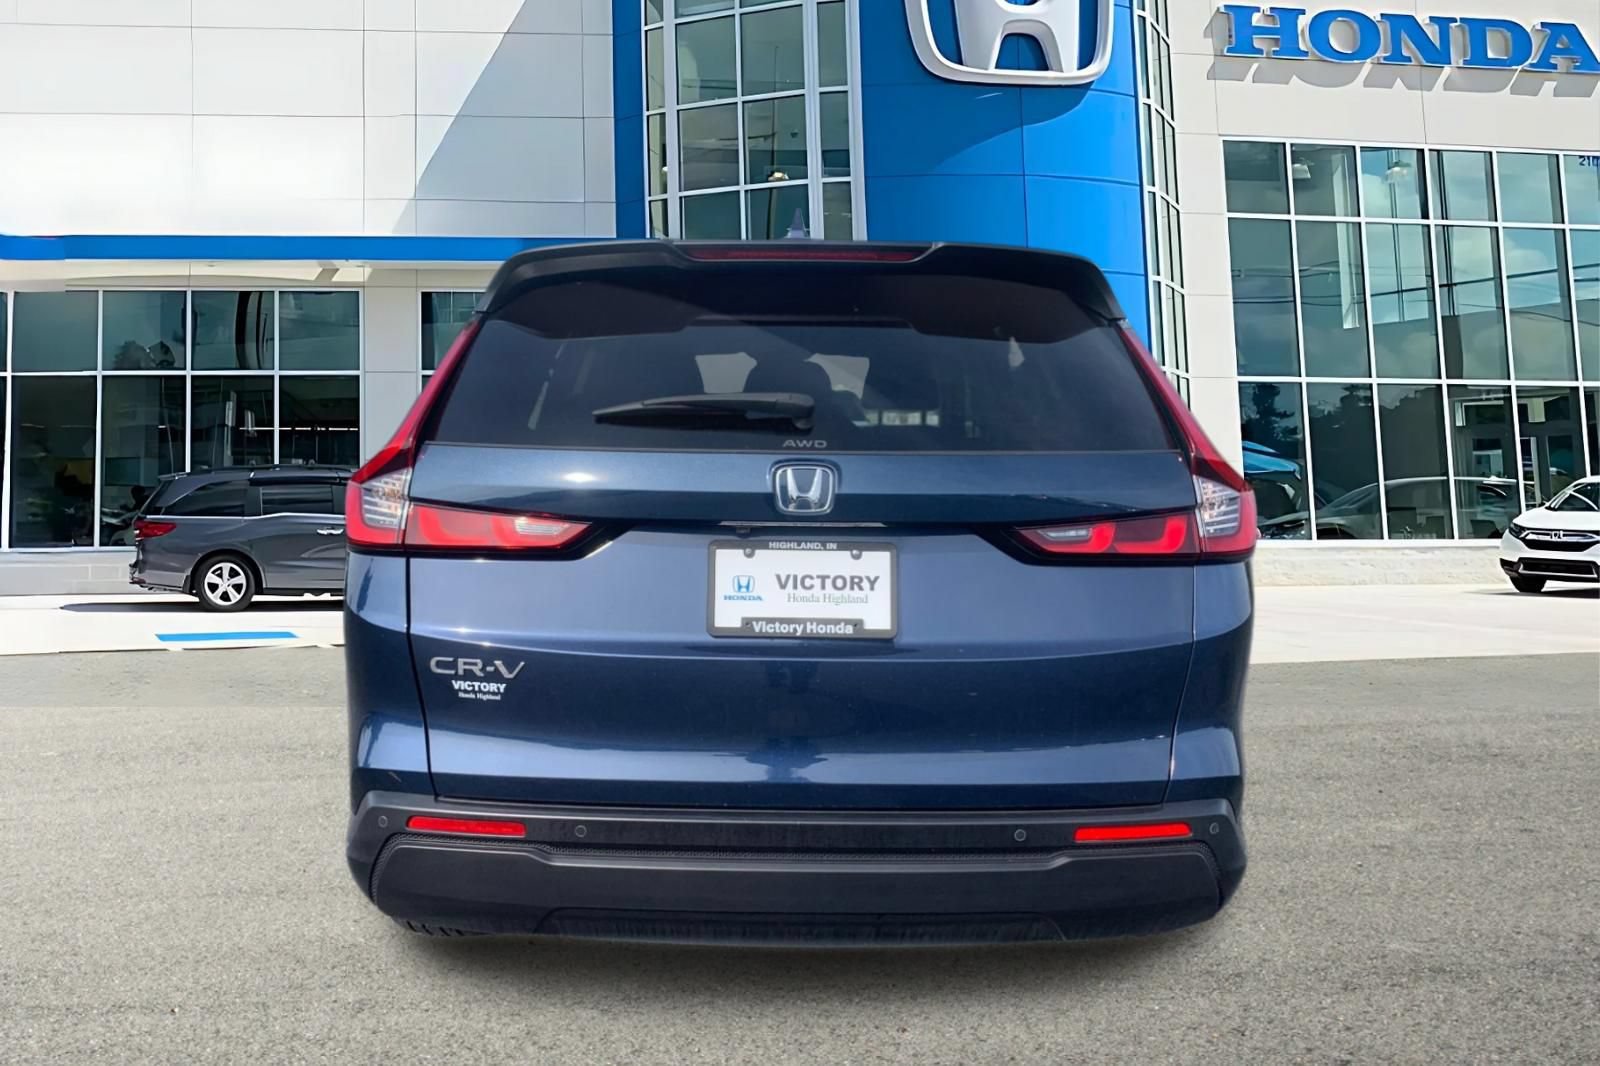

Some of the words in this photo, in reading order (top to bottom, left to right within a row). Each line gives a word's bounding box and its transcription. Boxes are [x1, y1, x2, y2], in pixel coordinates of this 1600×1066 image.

[1223, 4, 1600, 73] HONDA
[782, 439, 828, 449] AWD
[826, 542, 837, 550] IN
[775, 573, 880, 591] VICTORY
[787, 592, 820, 604] Honda
[823, 593, 869, 606] Highland
[752, 621, 801, 635] Victory
[806, 622, 854, 635] Honda
[430, 656, 525, 679] CR-V
[451, 679, 507, 693] VICTORY
